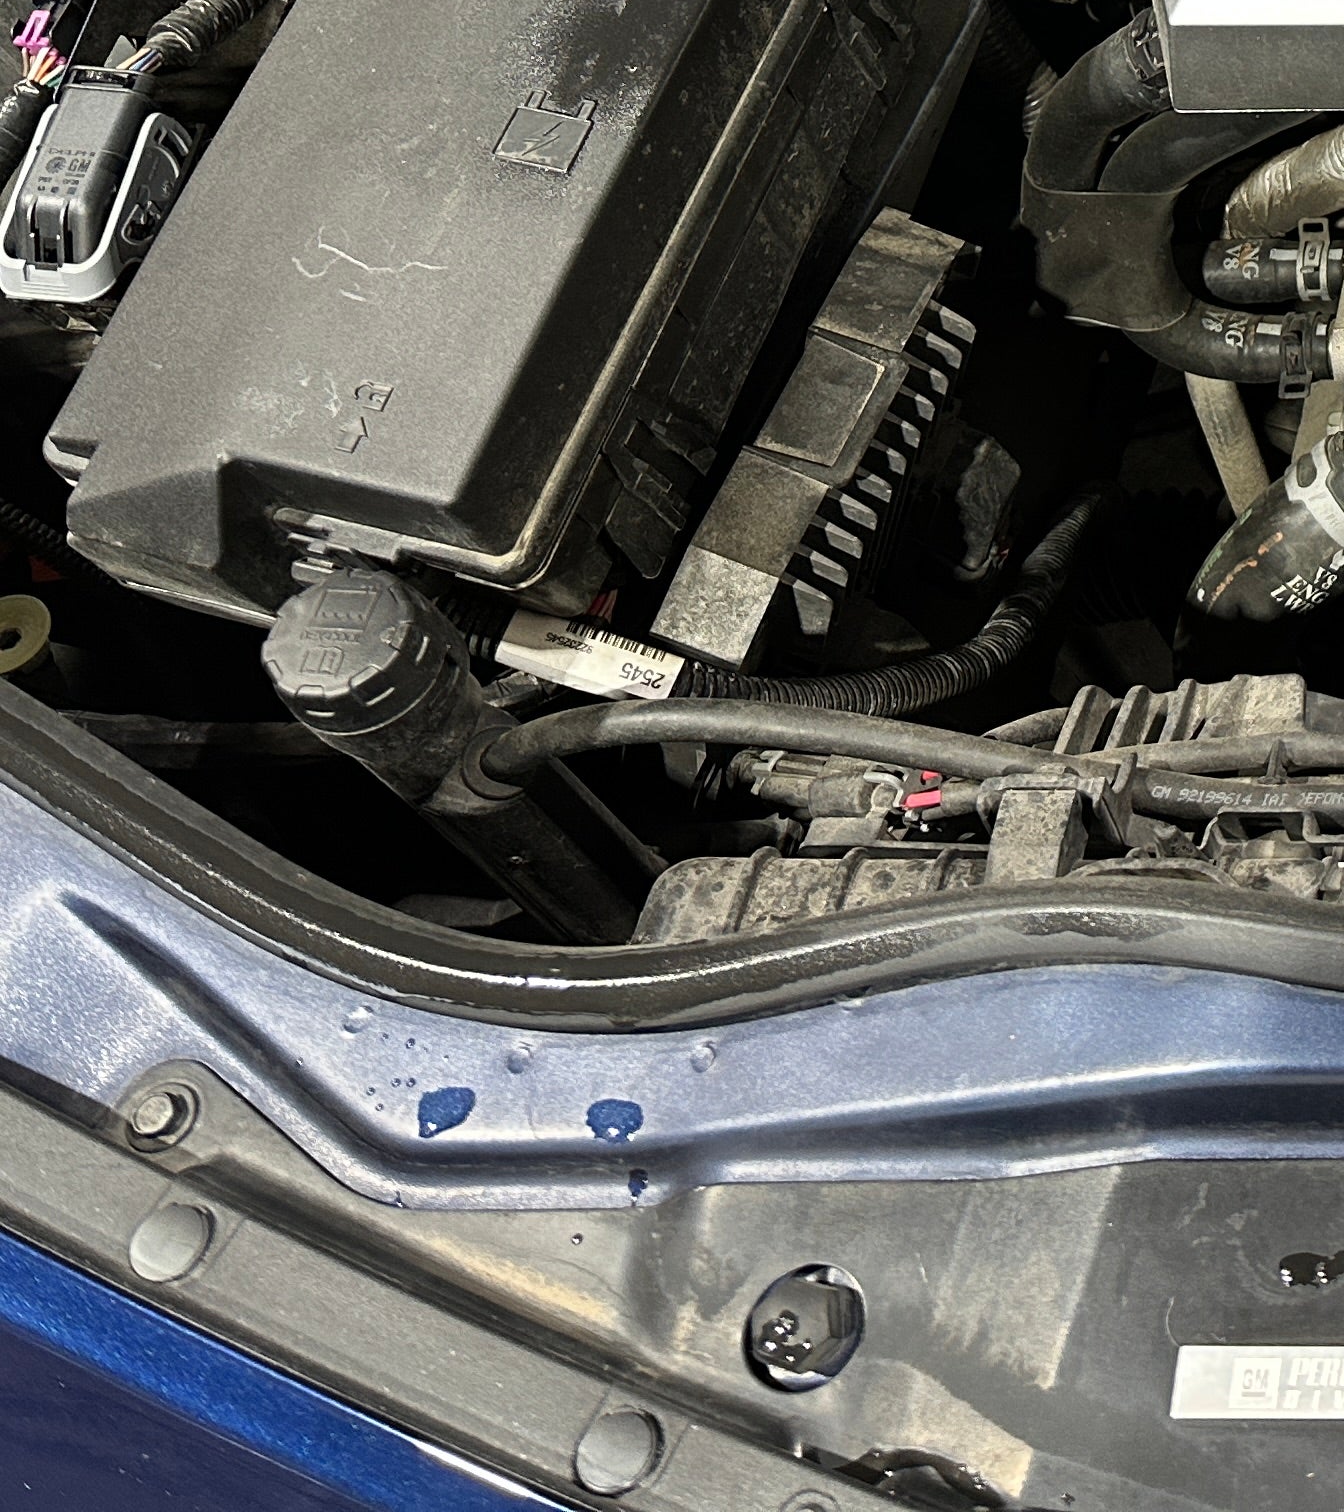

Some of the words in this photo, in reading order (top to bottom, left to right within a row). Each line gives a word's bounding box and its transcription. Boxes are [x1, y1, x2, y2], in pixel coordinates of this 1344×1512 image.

[68, 158, 91, 173] GM
[1222, 244, 1243, 270] V8
[1286, 574, 1329, 604] ENG
[545, 632, 593, 654] 92232545
[618, 661, 667, 690] 2545
[1151, 785, 1172, 800] GM
[1241, 1368, 1269, 1389] GM
